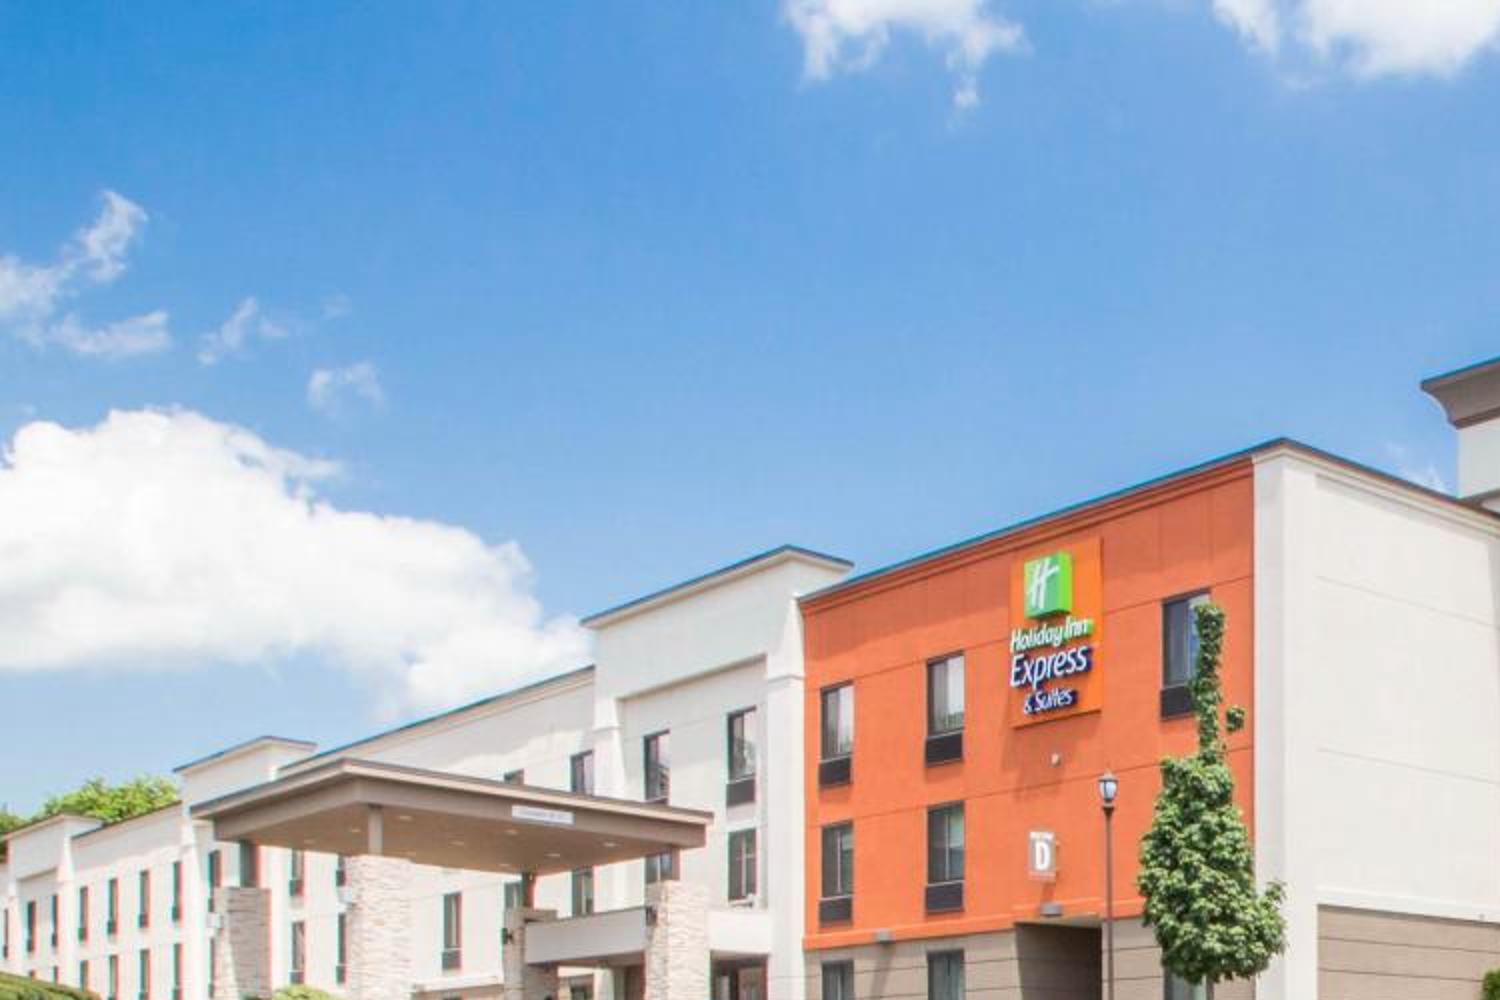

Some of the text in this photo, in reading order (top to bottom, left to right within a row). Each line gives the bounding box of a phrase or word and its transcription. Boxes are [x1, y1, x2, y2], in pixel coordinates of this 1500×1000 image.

[1010, 616, 1089, 653] Holiday Inn
[1010, 646, 1088, 689] Express
[1024, 688, 1073, 714] & Suites
[1035, 841, 1050, 870] D
